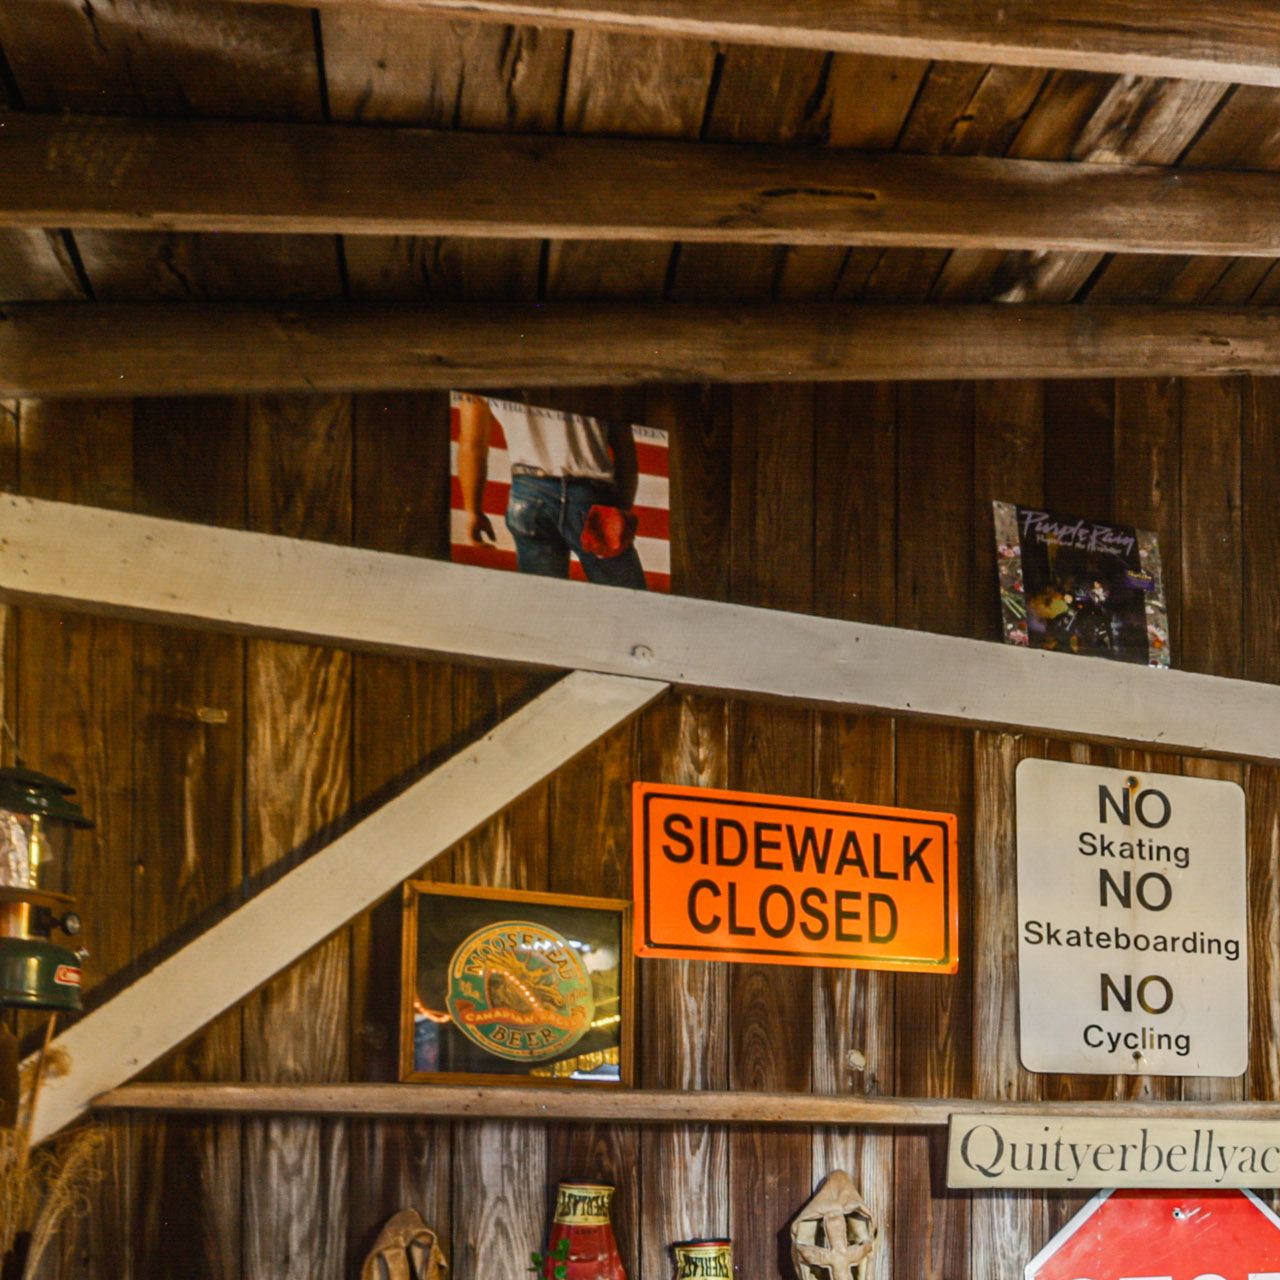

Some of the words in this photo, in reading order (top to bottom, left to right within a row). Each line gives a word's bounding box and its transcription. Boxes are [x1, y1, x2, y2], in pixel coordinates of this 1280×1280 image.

[1020, 510, 1089, 542] Purple
[1098, 784, 1172, 829] NO
[661, 813, 934, 884] SIDEWALK
[1078, 832, 1190, 868] Skating
[687, 878, 899, 944] CLOSED
[1099, 868, 1173, 912] NO
[464, 932, 573, 981] MOOSEEAD
[1024, 920, 1240, 961] Skateboarding
[1100, 973, 1174, 1015] NO
[490, 1025, 559, 1048] BEER
[1083, 1024, 1191, 1056] Cycling
